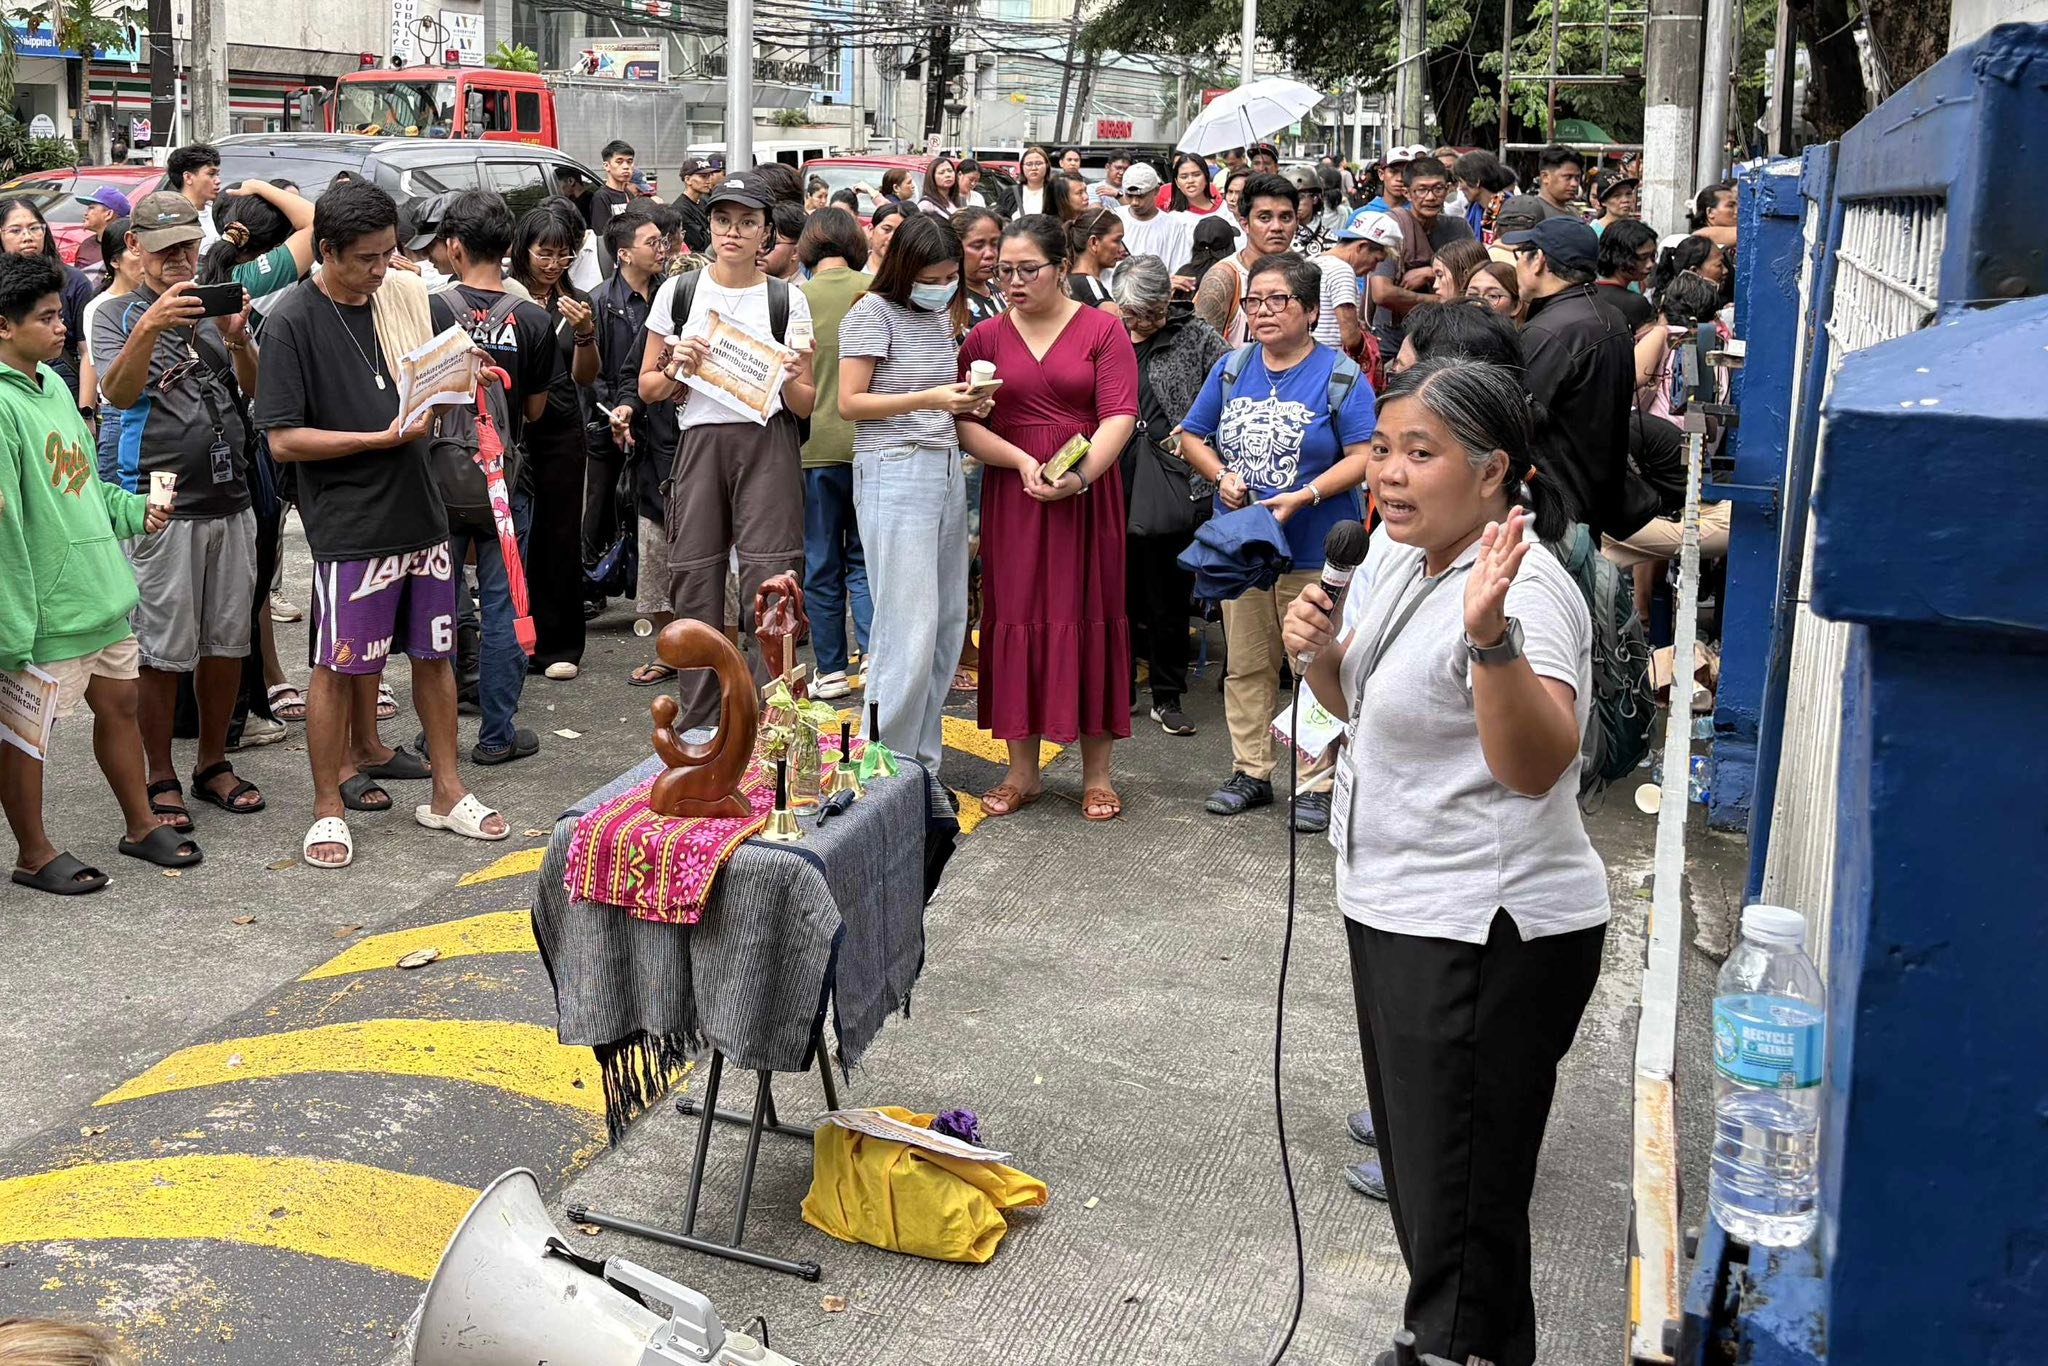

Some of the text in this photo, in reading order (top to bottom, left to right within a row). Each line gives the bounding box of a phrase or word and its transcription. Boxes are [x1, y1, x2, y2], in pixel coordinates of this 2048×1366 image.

[402, 0, 413, 46] UBLIC
[719, 338, 769, 373] Huwag kang
[349, 541, 452, 602] LAKERS
[431, 614, 453, 653] 6
[25, 690, 41, 706] ang
[1742, 1025, 1795, 1045] RECYCLE
